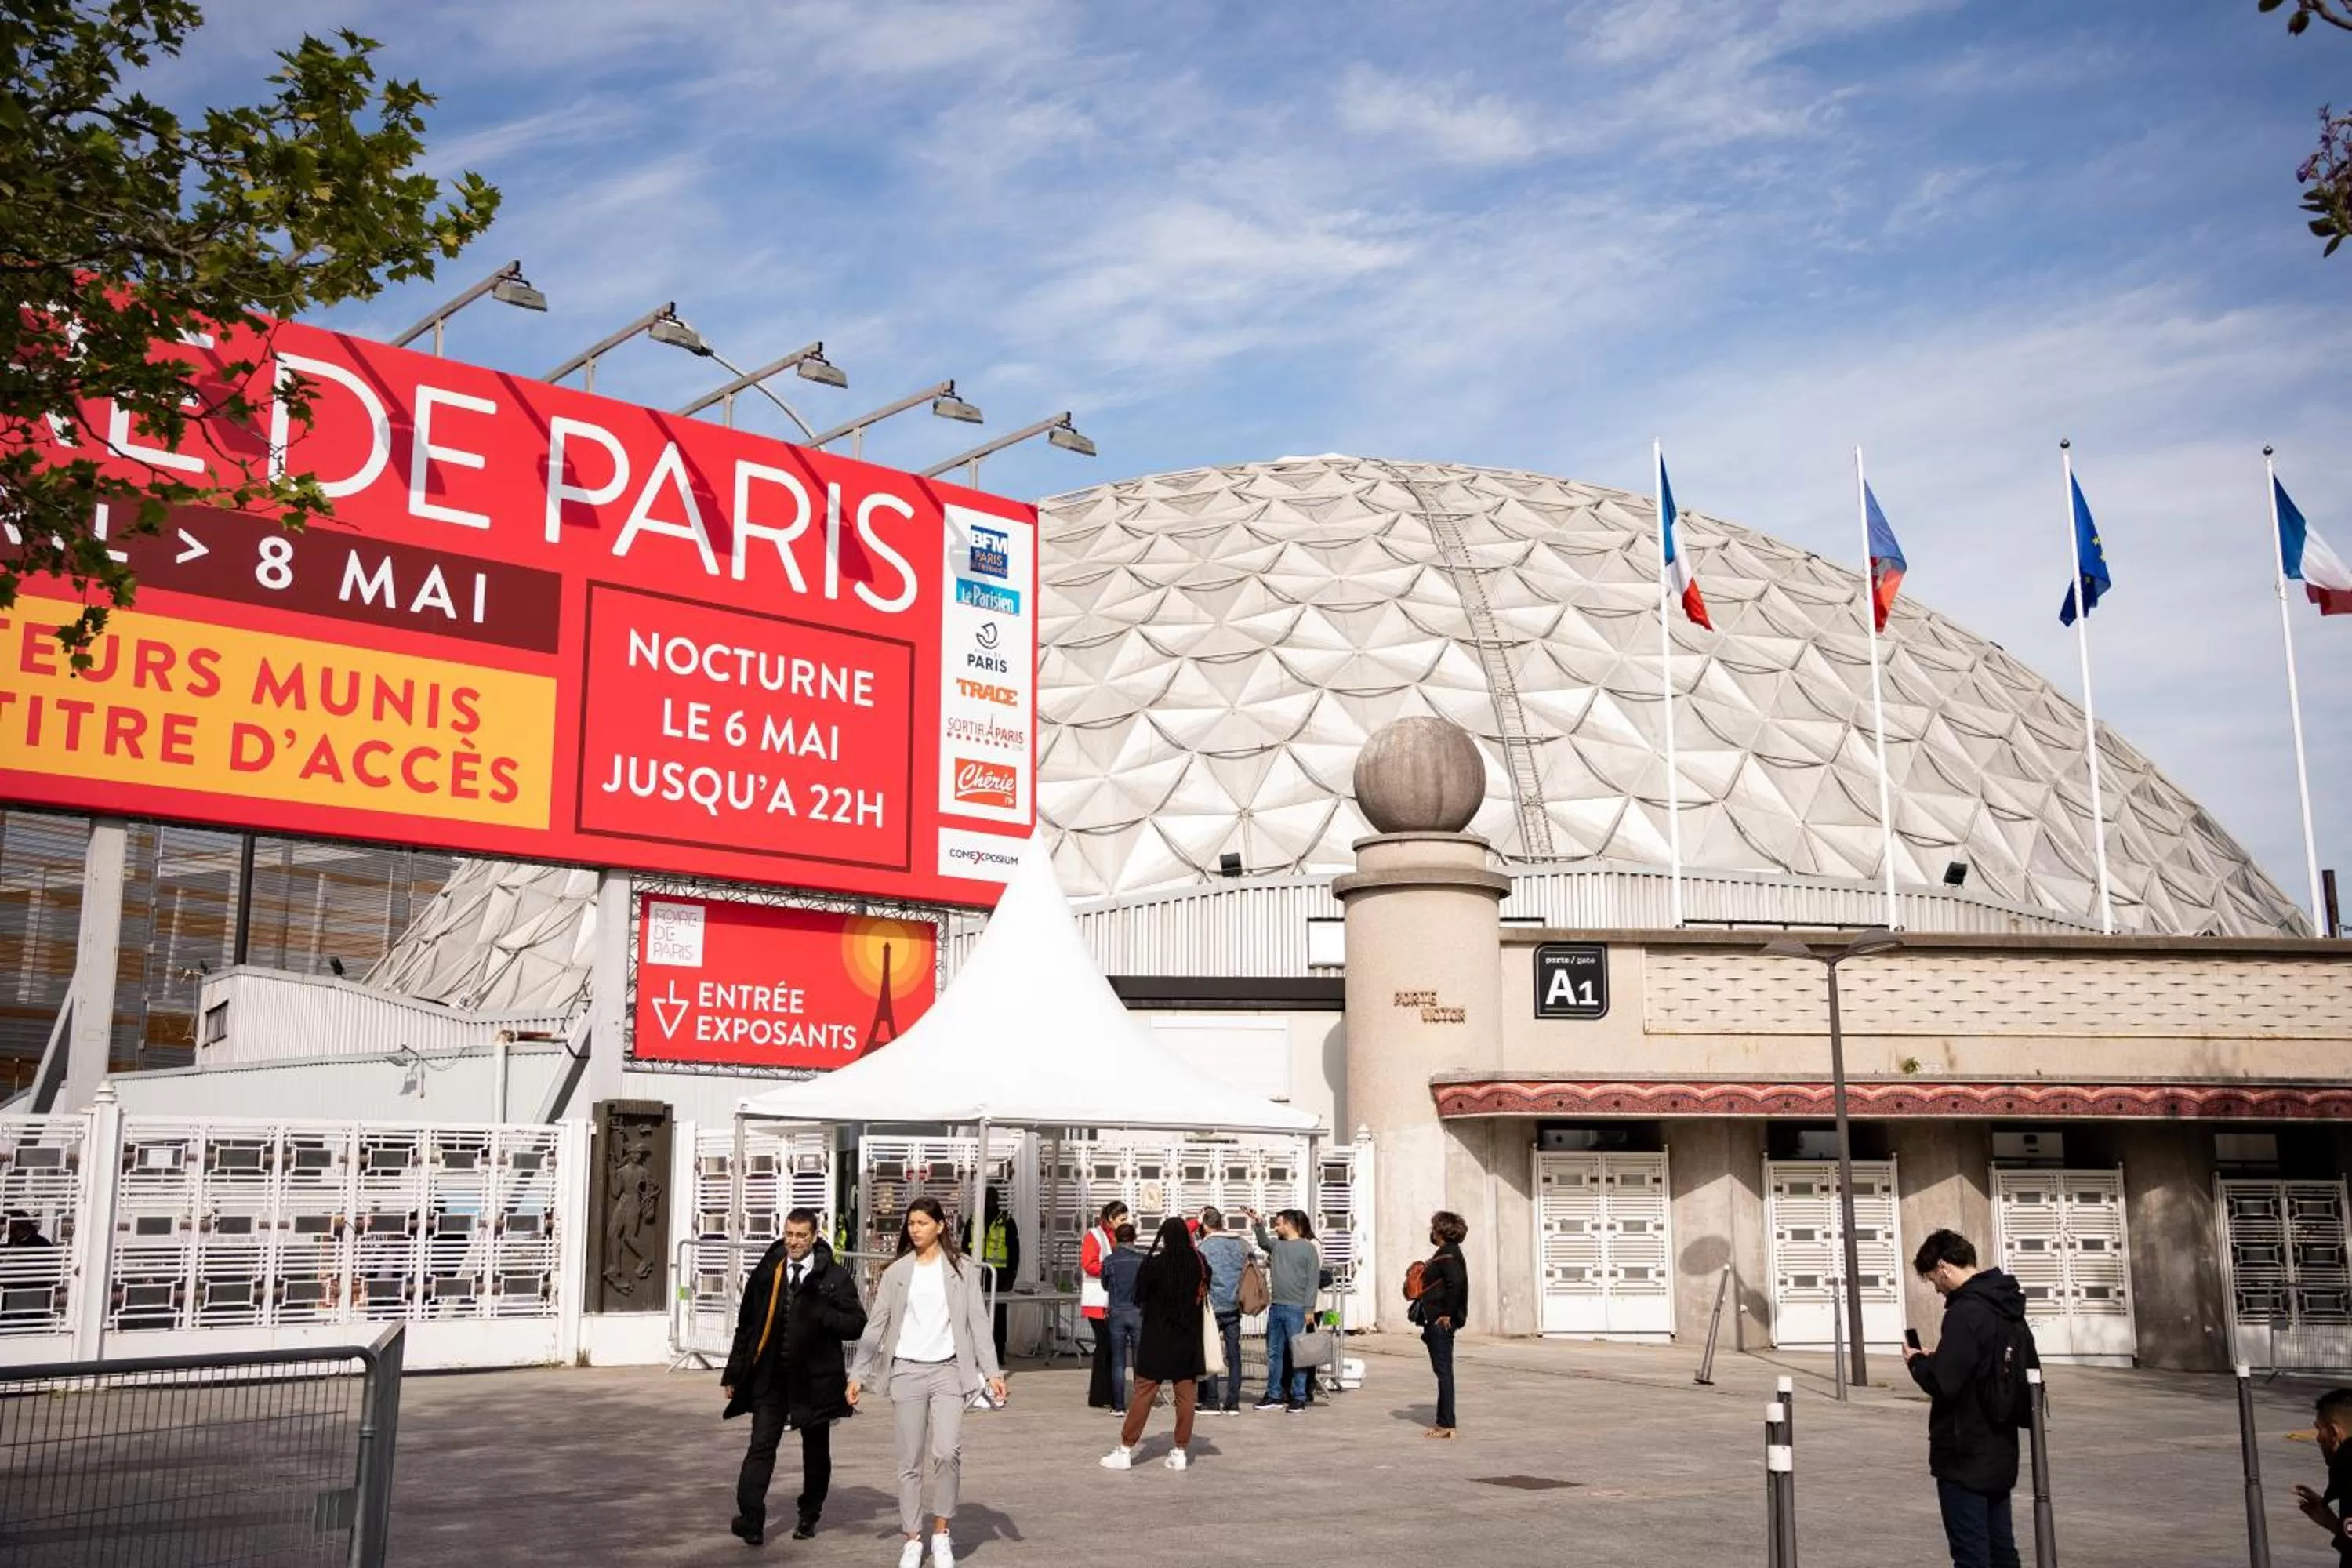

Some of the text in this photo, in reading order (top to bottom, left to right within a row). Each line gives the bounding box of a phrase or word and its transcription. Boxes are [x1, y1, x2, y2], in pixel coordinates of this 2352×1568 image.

[267, 352, 496, 529] DE
[545, 416, 917, 613] PARIS
[970, 530, 1008, 554] BFM
[975, 550, 1004, 566] PARIS
[255, 536, 293, 590] 8
[338, 549, 486, 623] MAI
[973, 584, 1014, 615] Parisien
[0, 618, 481, 734] EURS MUNIS
[629, 628, 874, 707] NOCTURNE
[967, 653, 1007, 673] PARIS
[956, 677, 1018, 706] TRACE
[663, 698, 839, 761] LE 6 MAI
[229, 722, 520, 804] D'ACCÈS
[957, 763, 1014, 791] Chérie
[602, 754, 884, 829] JUSQU'A 22H
[949, 848, 1018, 866] COMEXPOSIUM
[653, 925, 675, 942] DE
[655, 909, 697, 927] FOIRE
[653, 941, 694, 960] PARIS
[1545, 956, 1570, 965] porte
[698, 981, 804, 1014] ENTRÉE
[1545, 968, 1599, 1006] A1
[696, 1015, 857, 1051] EXPOSANTS
